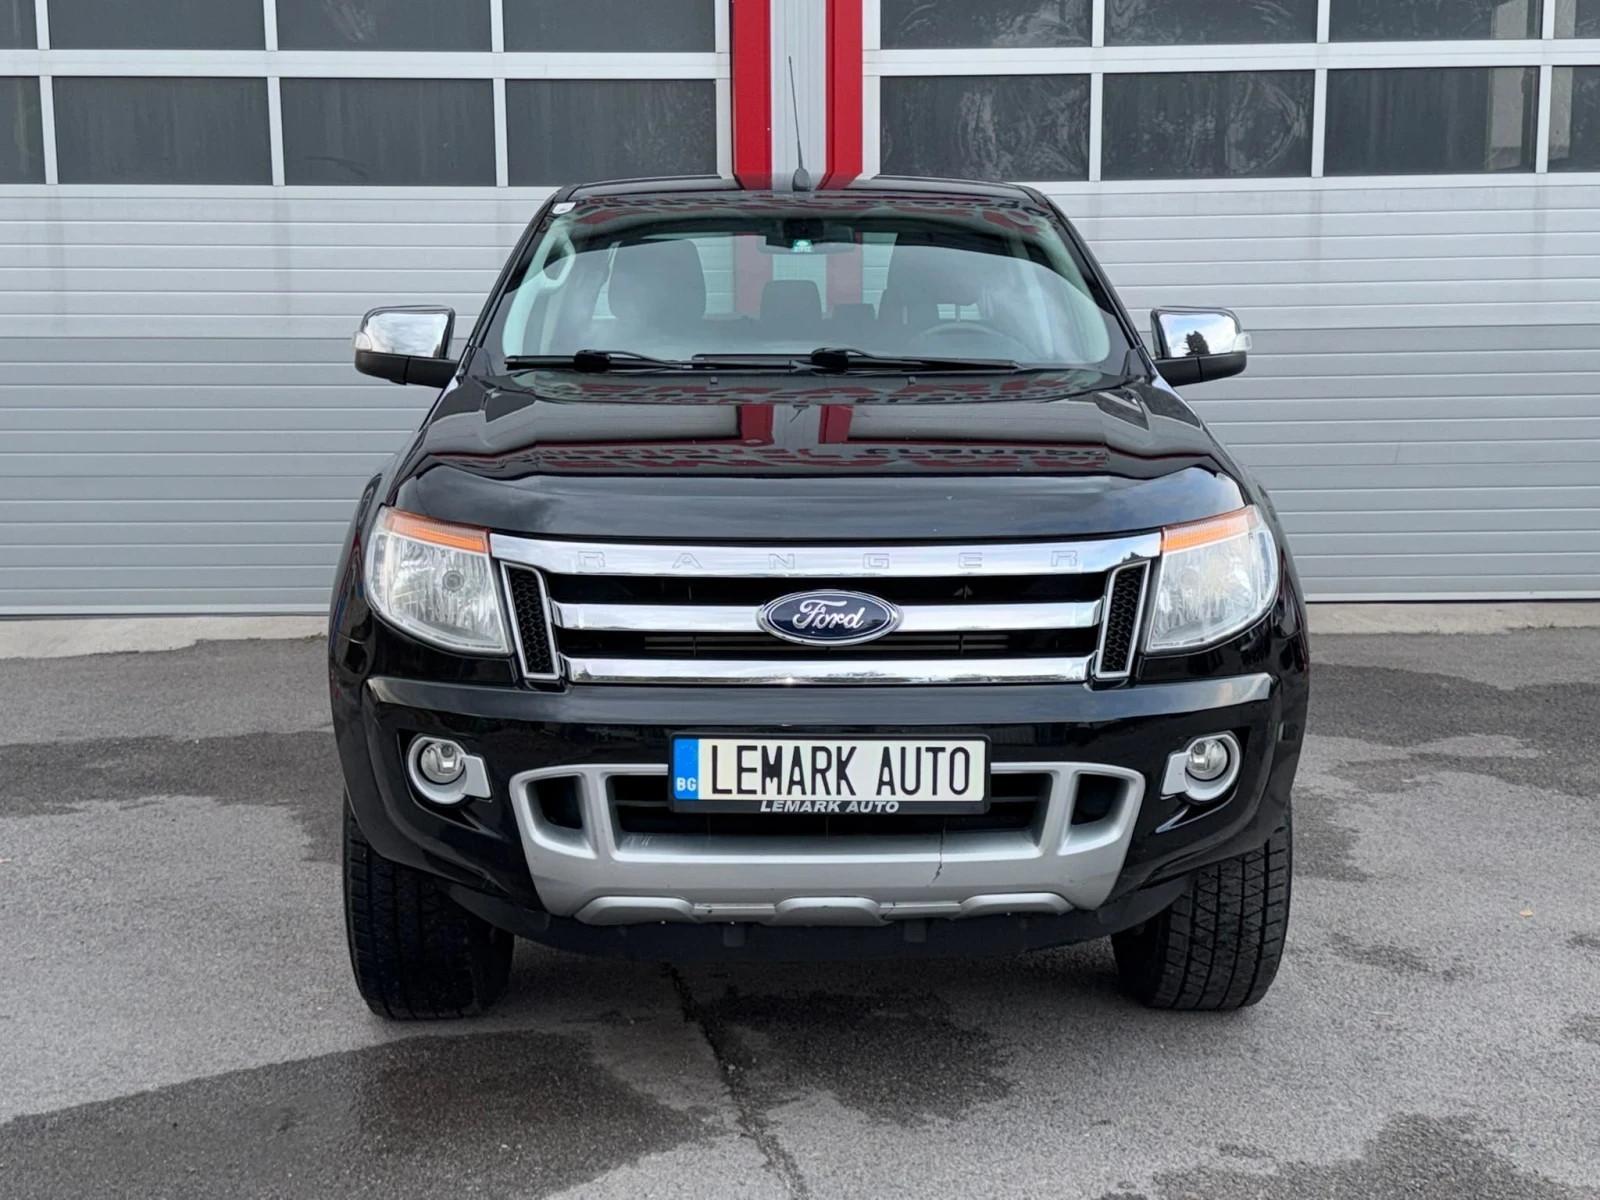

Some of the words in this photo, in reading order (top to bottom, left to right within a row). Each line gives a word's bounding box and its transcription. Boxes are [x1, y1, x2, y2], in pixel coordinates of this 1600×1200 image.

[577, 550, 1078, 570] RANGER
[792, 599, 866, 629] Ford
[711, 744, 857, 795] LEMARK
[876, 746, 971, 796] AUTO
[676, 777, 697, 791] BG
[760, 800, 841, 813] LEMARK
[845, 800, 900, 813] AUTO
